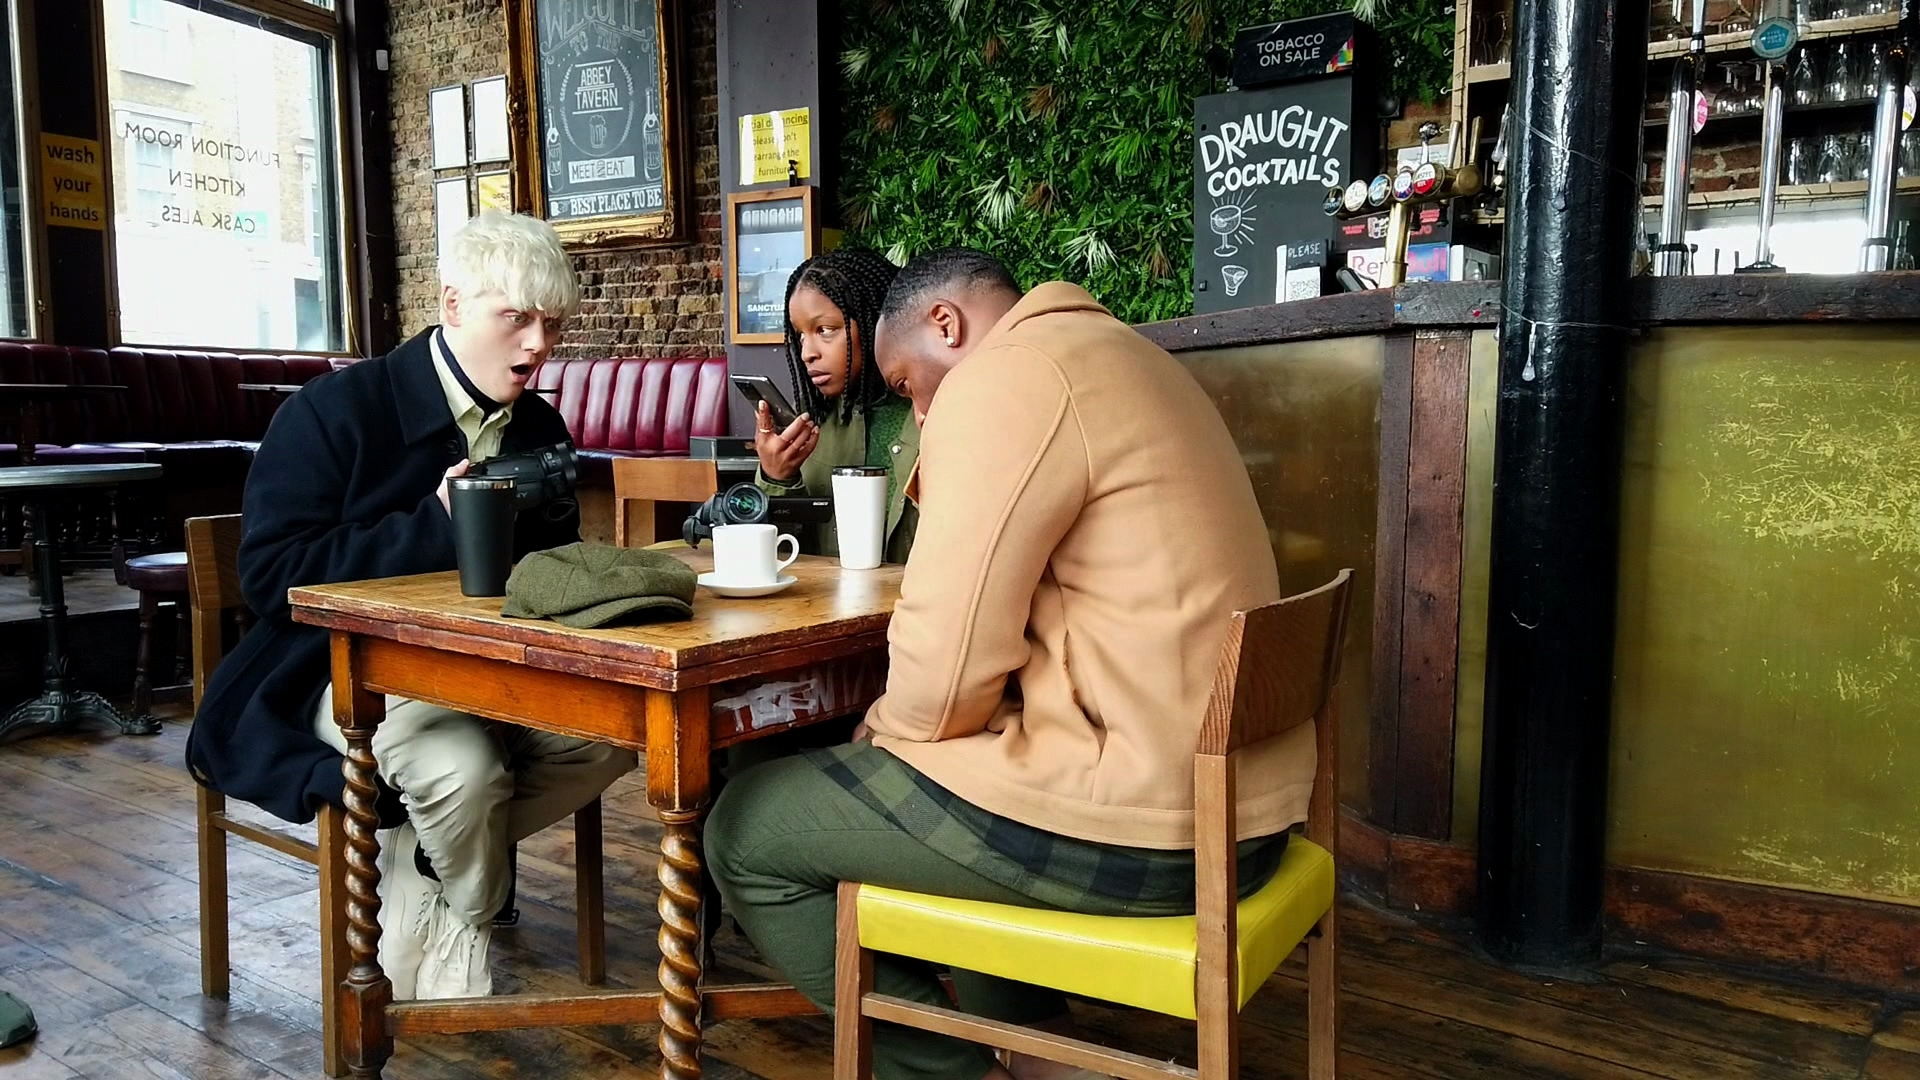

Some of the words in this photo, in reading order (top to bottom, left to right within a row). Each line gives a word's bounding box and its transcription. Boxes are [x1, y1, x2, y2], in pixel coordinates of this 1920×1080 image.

[1257, 33, 1325, 54] TOBACCO
[1260, 52, 1282, 67] ON
[1285, 47, 1320, 63] SALE
[581, 65, 611, 86] ABBEY
[575, 88, 618, 110] TAVERN
[1200, 105, 1349, 173] DRAUGHT
[47, 145, 95, 165] wash
[787, 148, 799, 157] the
[571, 162, 595, 180] MEET
[606, 160, 625, 177] EAT
[759, 165, 790, 177] furnitur
[1207, 157, 1341, 197] COCKTAILS
[53, 176, 91, 194] your
[50, 202, 98, 222] hands
[570, 197, 597, 216] BEST
[598, 190, 631, 213] PLACE
[632, 191, 645, 209] TO
[647, 188, 662, 207] BE
[1288, 243, 1321, 258] PLEASE
